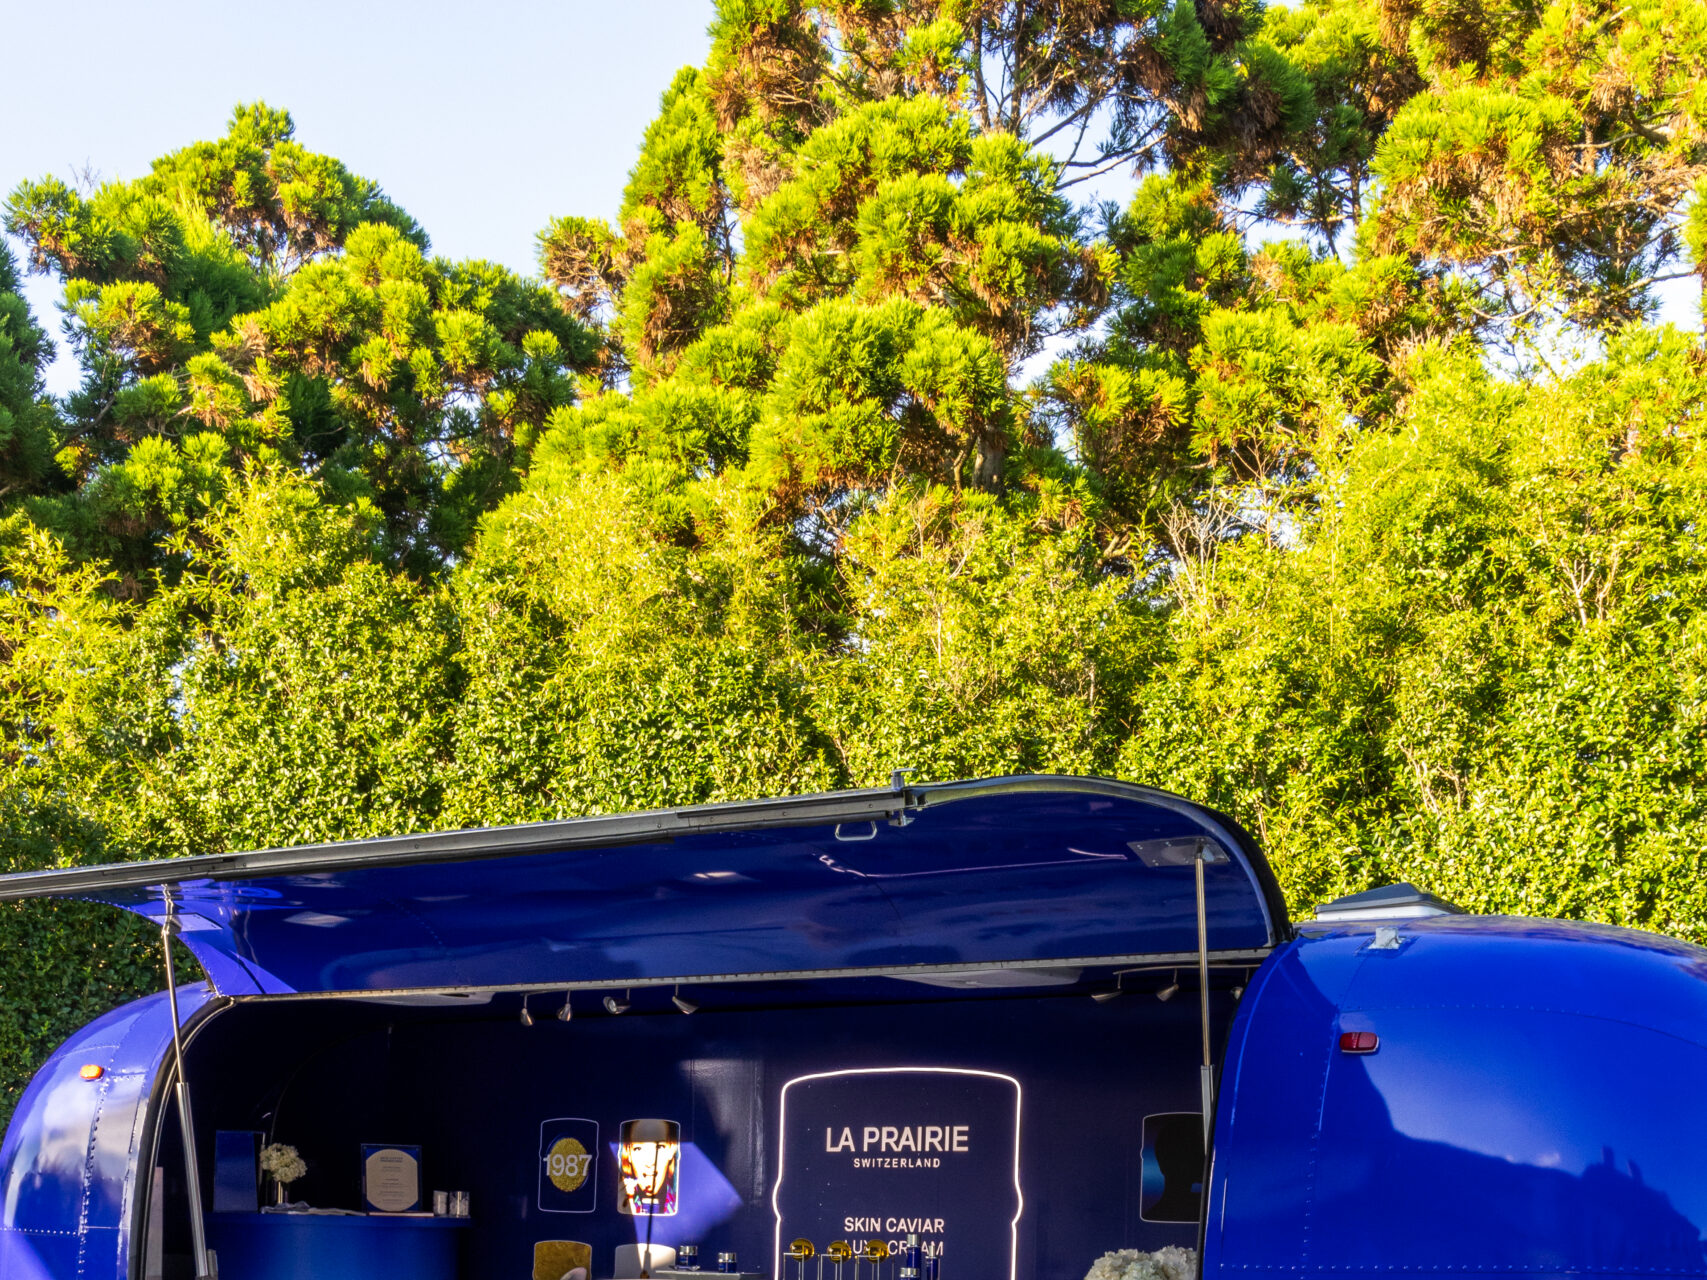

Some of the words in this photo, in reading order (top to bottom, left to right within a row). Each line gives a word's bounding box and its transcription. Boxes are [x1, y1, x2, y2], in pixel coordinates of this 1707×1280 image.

[826, 1126, 855, 1152] LA
[863, 1125, 969, 1152] PRAIRIE
[543, 1154, 593, 1177] 1987
[853, 1157, 941, 1168] SWITZERLAND
[844, 1216, 881, 1232] SKIN
[885, 1217, 944, 1233] CAVIAR
[887, 1240, 945, 1256] CRAM
